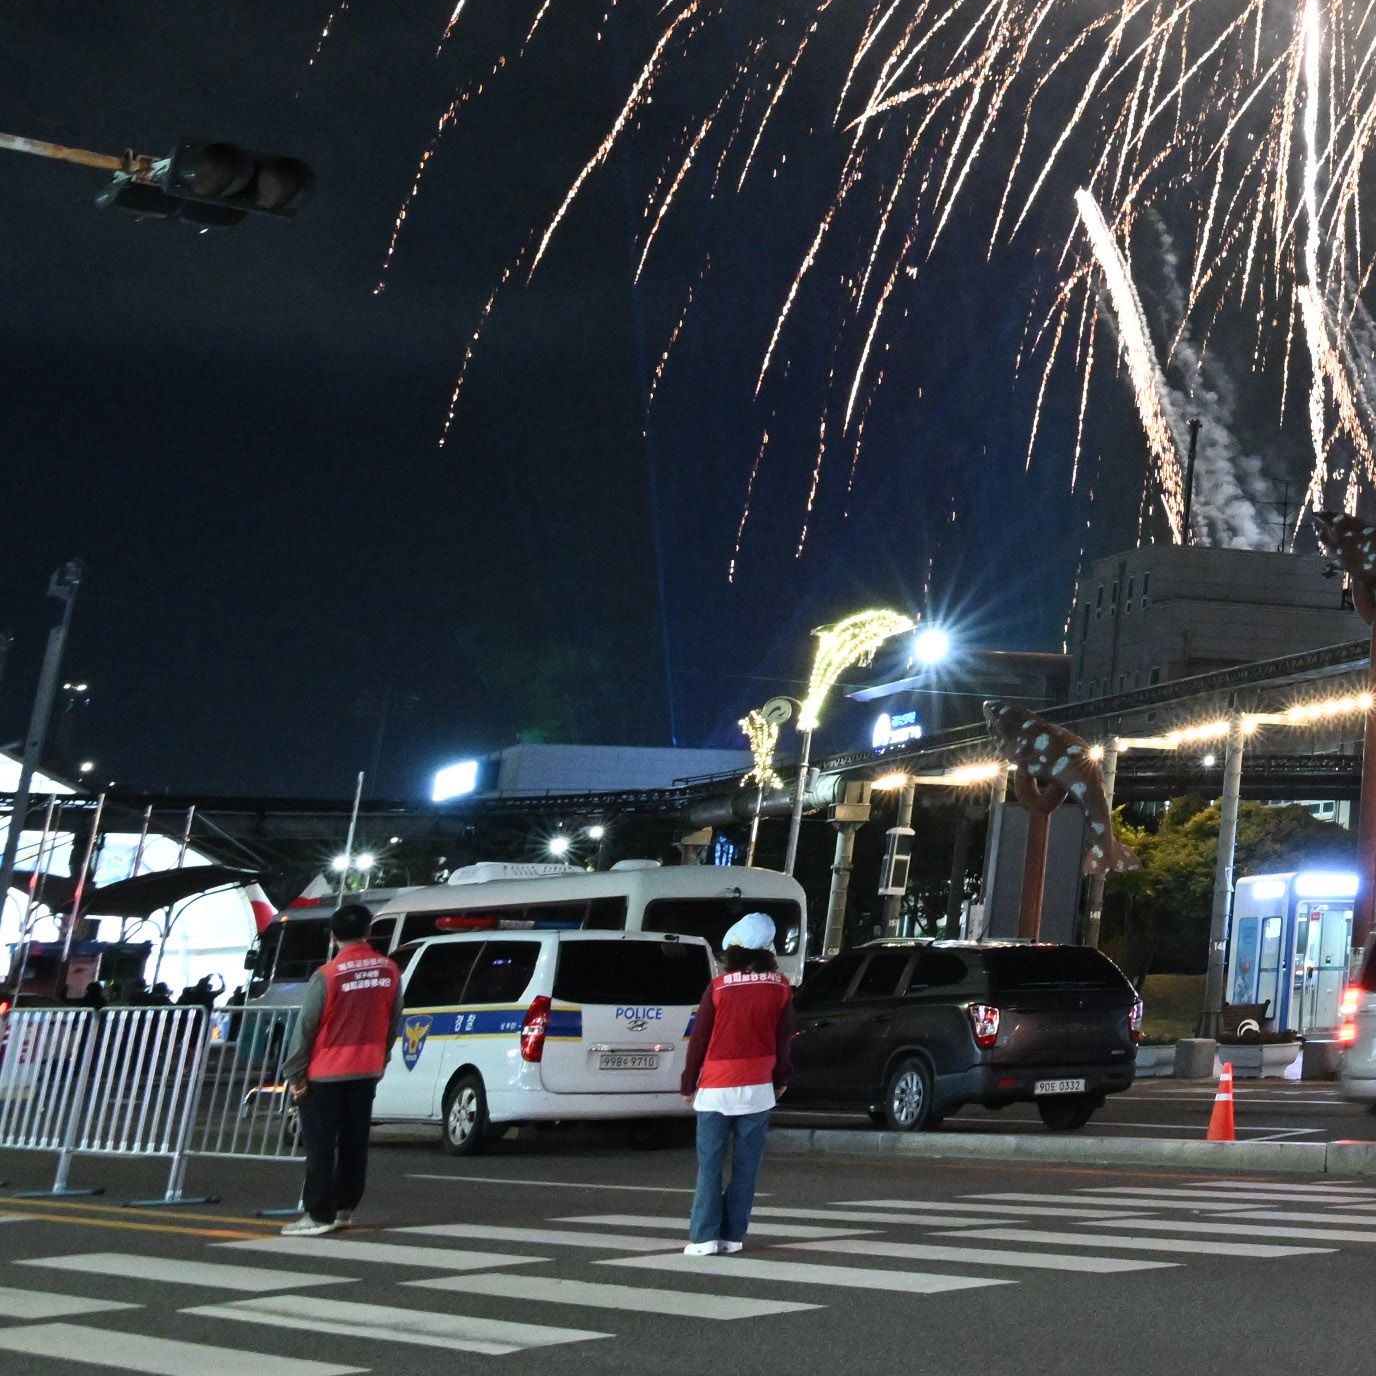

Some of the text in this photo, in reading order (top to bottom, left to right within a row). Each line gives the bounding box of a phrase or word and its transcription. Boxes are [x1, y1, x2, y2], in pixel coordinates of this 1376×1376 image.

[616, 1007, 663, 1020] POLICE
[454, 1014, 476, 1032] 경찰
[631, 1056, 655, 1067] 9710
[1059, 1080, 1081, 1092] 0332
